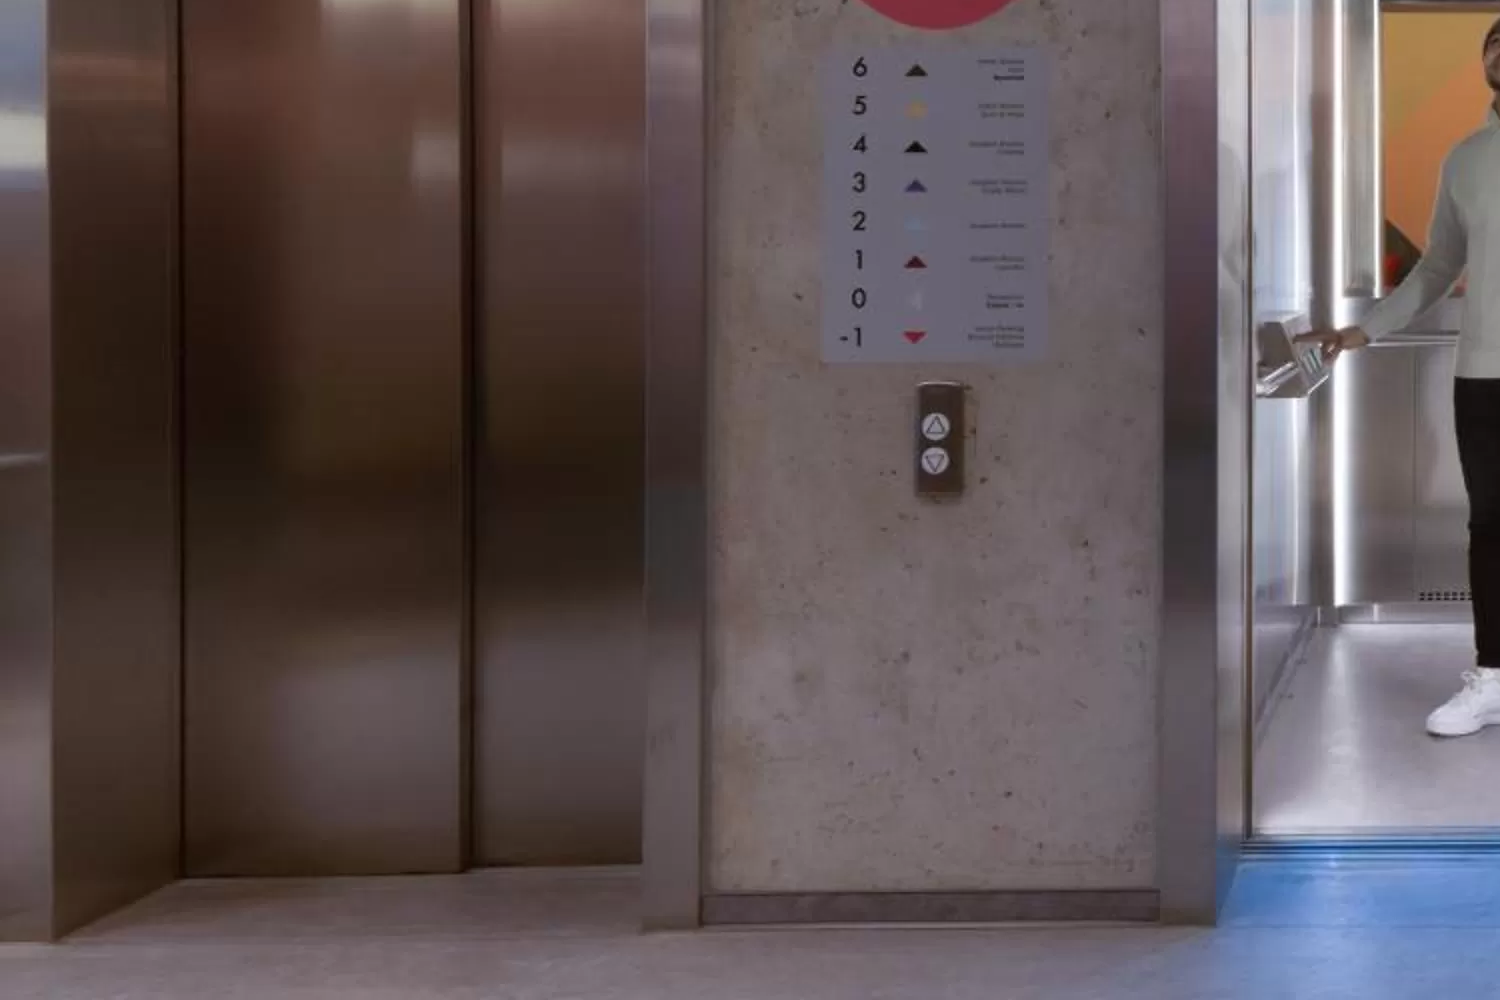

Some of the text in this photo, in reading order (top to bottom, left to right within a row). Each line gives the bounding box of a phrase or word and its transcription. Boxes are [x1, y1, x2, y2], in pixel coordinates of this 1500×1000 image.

[852, 56, 868, 78] 6
[852, 95, 867, 115] 5
[852, 134, 868, 154] 4
[851, 171, 866, 193] 3
[851, 210, 867, 231] 2
[854, 249, 863, 270] 1
[851, 287, 867, 309] 0
